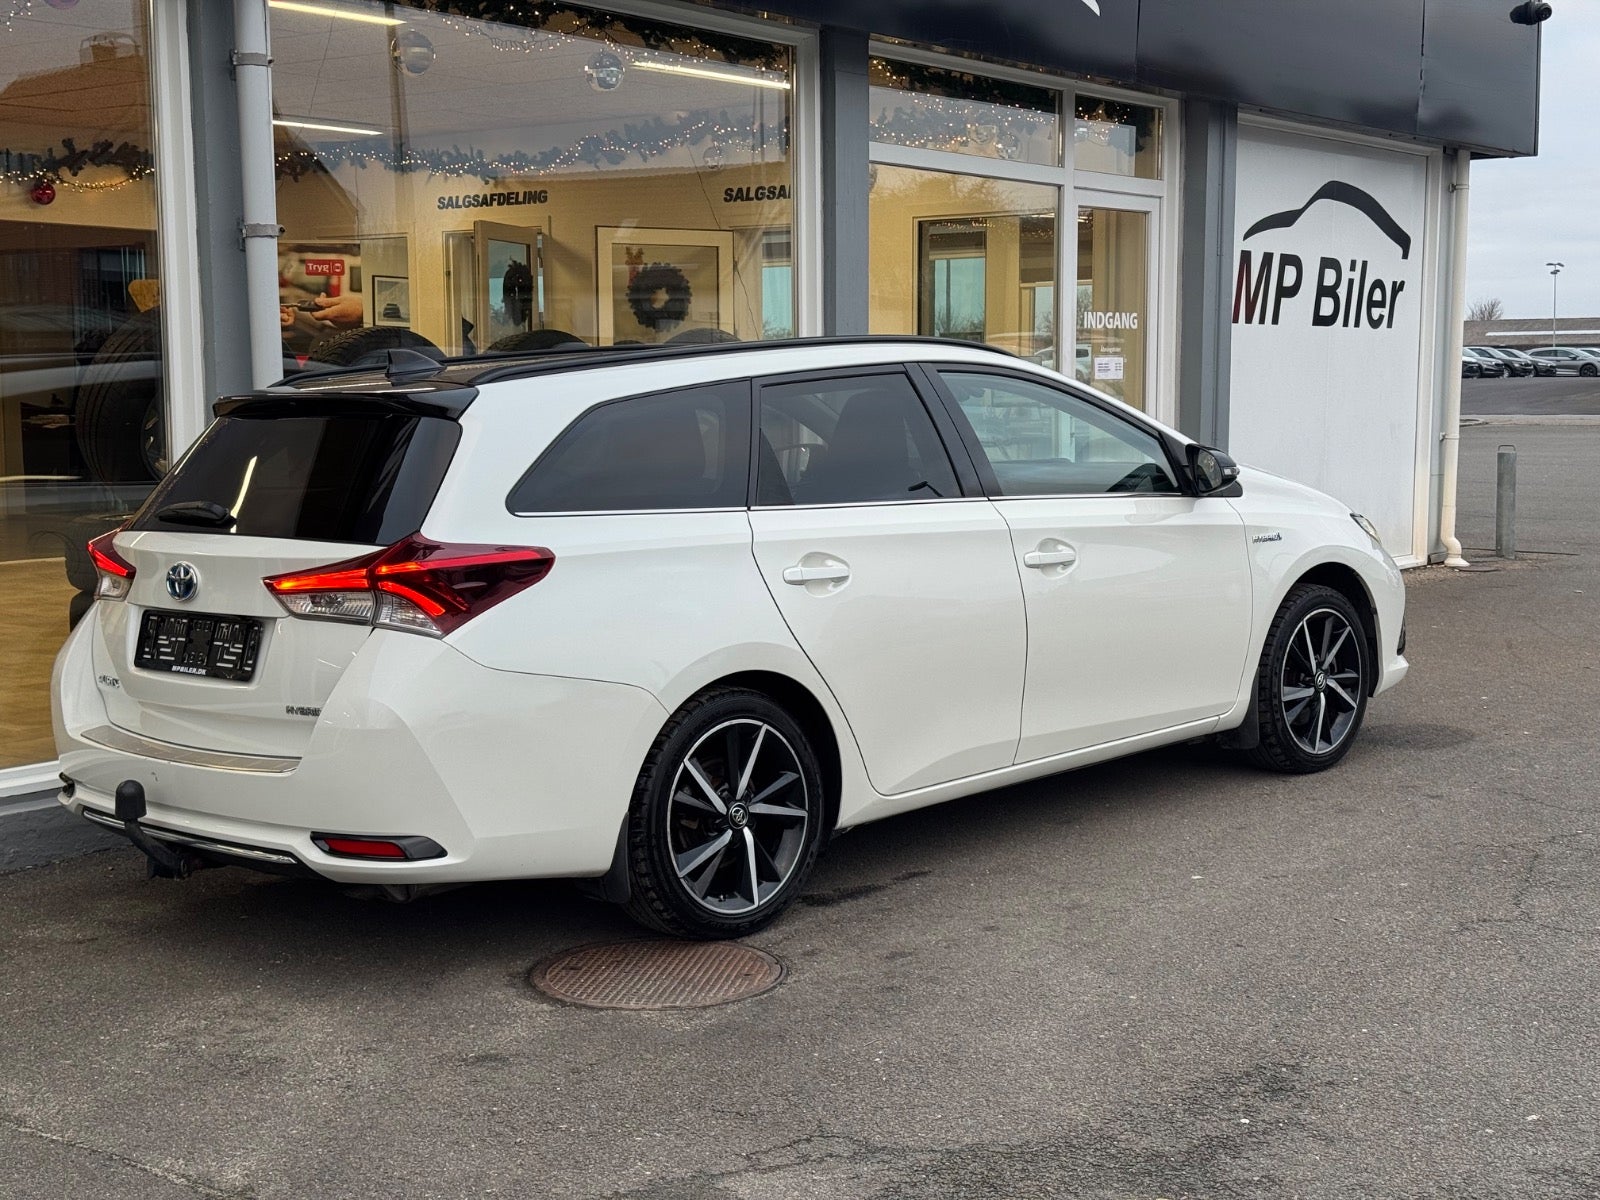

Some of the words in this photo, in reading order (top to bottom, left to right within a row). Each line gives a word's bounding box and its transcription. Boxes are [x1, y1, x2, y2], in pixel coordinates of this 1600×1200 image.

[437, 189, 548, 210] SALGSAFDELING
[723, 184, 791, 203] SALGSA
[306, 263, 330, 273] Tryg
[1231, 249, 1304, 326] MP
[1311, 256, 1406, 330] Biler
[1083, 311, 1138, 330] INDGANG
